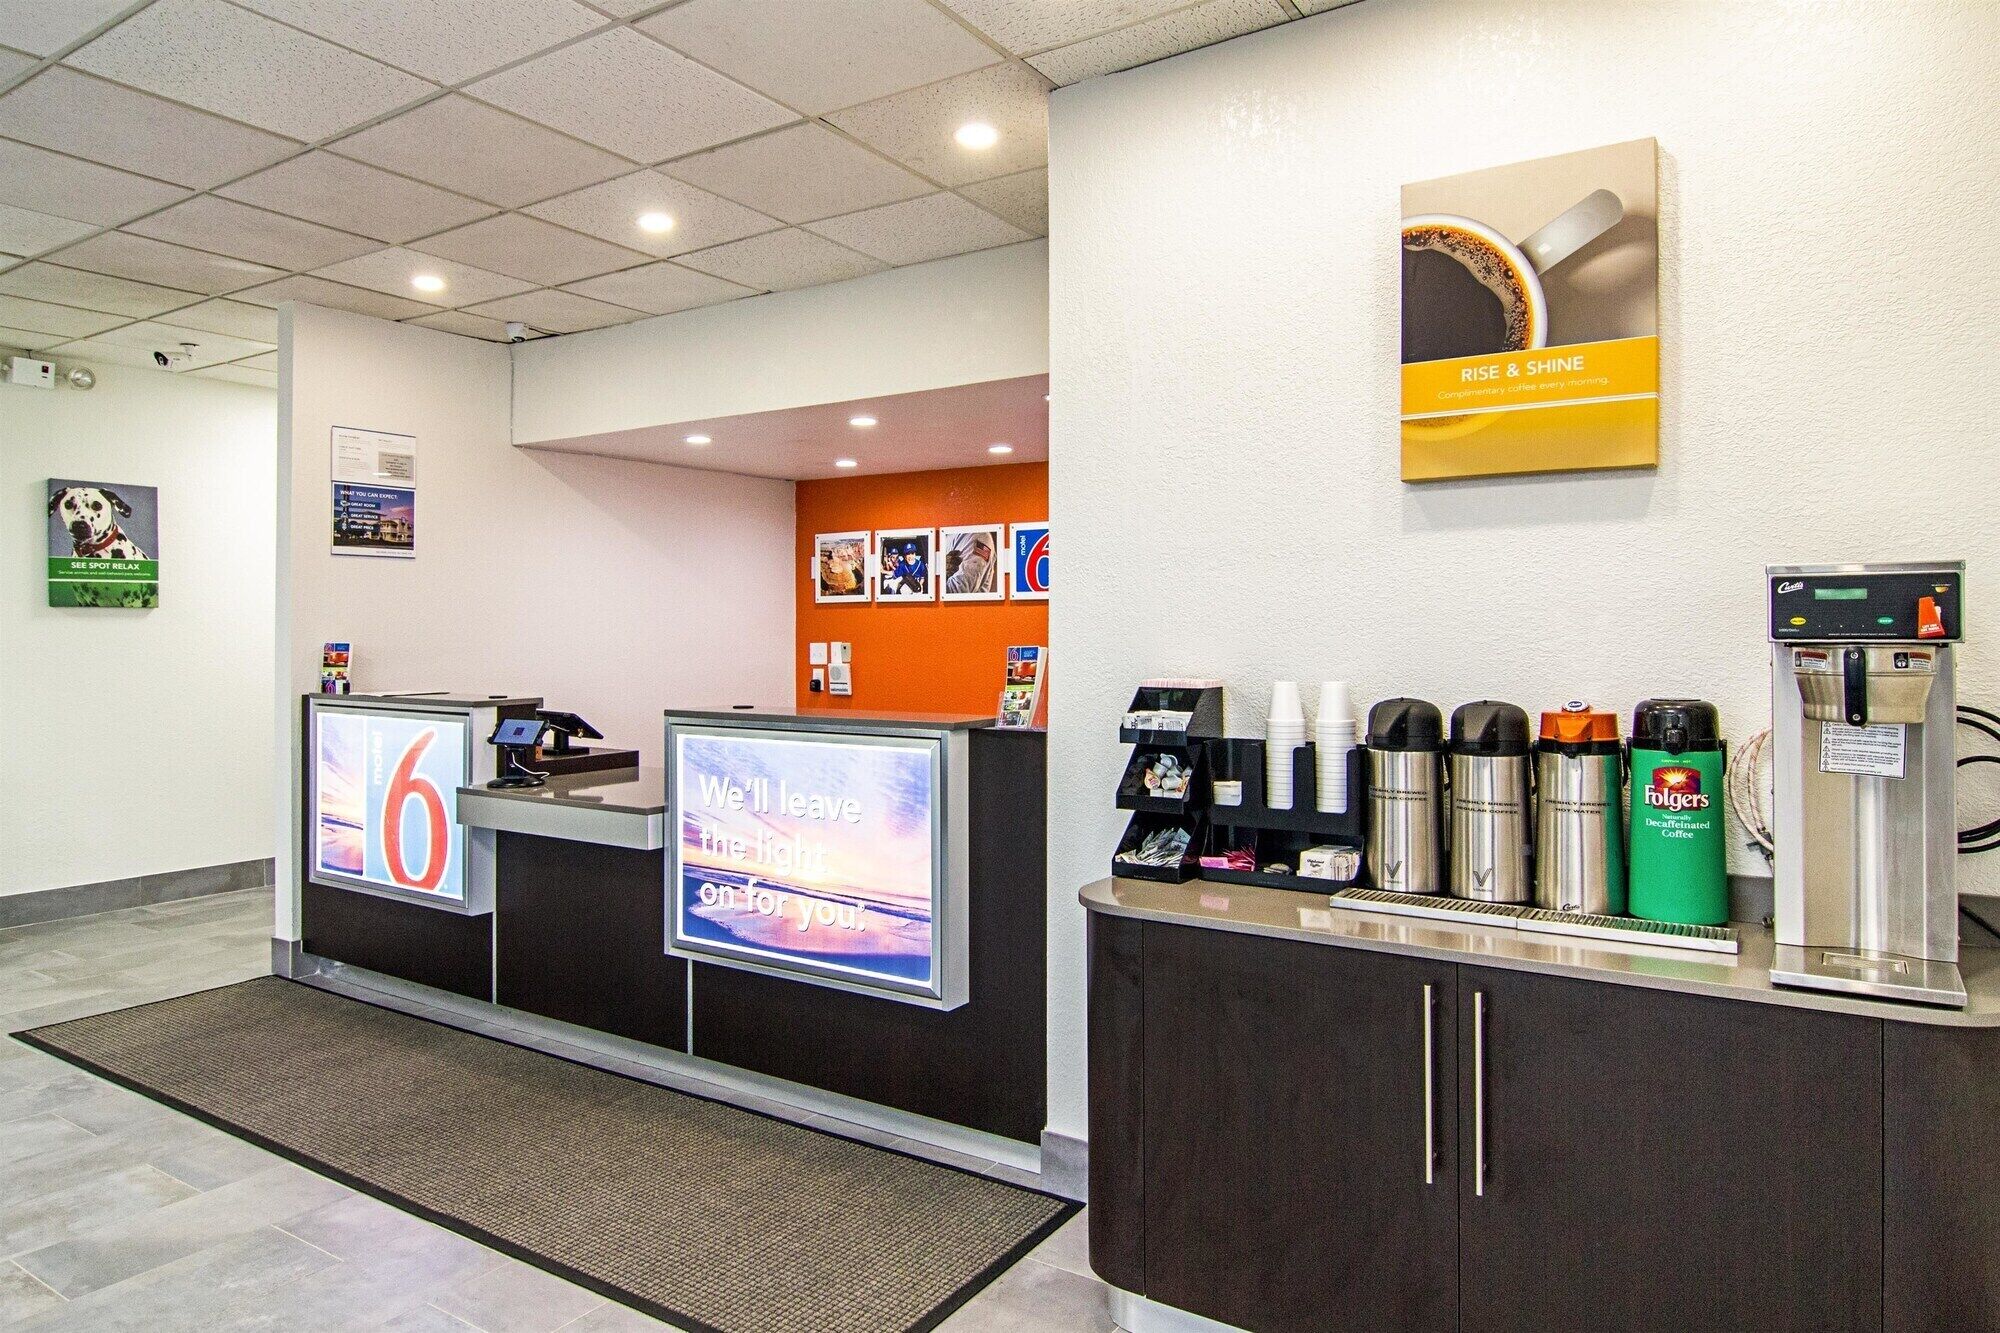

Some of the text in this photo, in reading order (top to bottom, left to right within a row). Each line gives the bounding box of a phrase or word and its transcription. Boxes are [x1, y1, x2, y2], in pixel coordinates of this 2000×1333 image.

[1461, 355, 1585, 382] RISE & SHINE
[1437, 376, 1610, 400] Complimentary coffee every morning.
[71, 561, 87, 569] SEE
[112, 562, 140, 570] RELAX
[1777, 581, 1804, 594] Curtis
[371, 730, 384, 786] motel
[381, 725, 451, 892] 6
[698, 774, 864, 824] We'll leave
[1457, 805, 1487, 813] REGULAR
[1644, 784, 1710, 812] Folgers
[1645, 817, 1710, 829] Decaffeinated
[1661, 813, 1692, 821] Naturally
[1661, 829, 1694, 839] Coffee
[699, 823, 828, 877] the light
[699, 880, 736, 910] on
[745, 877, 790, 918] for
